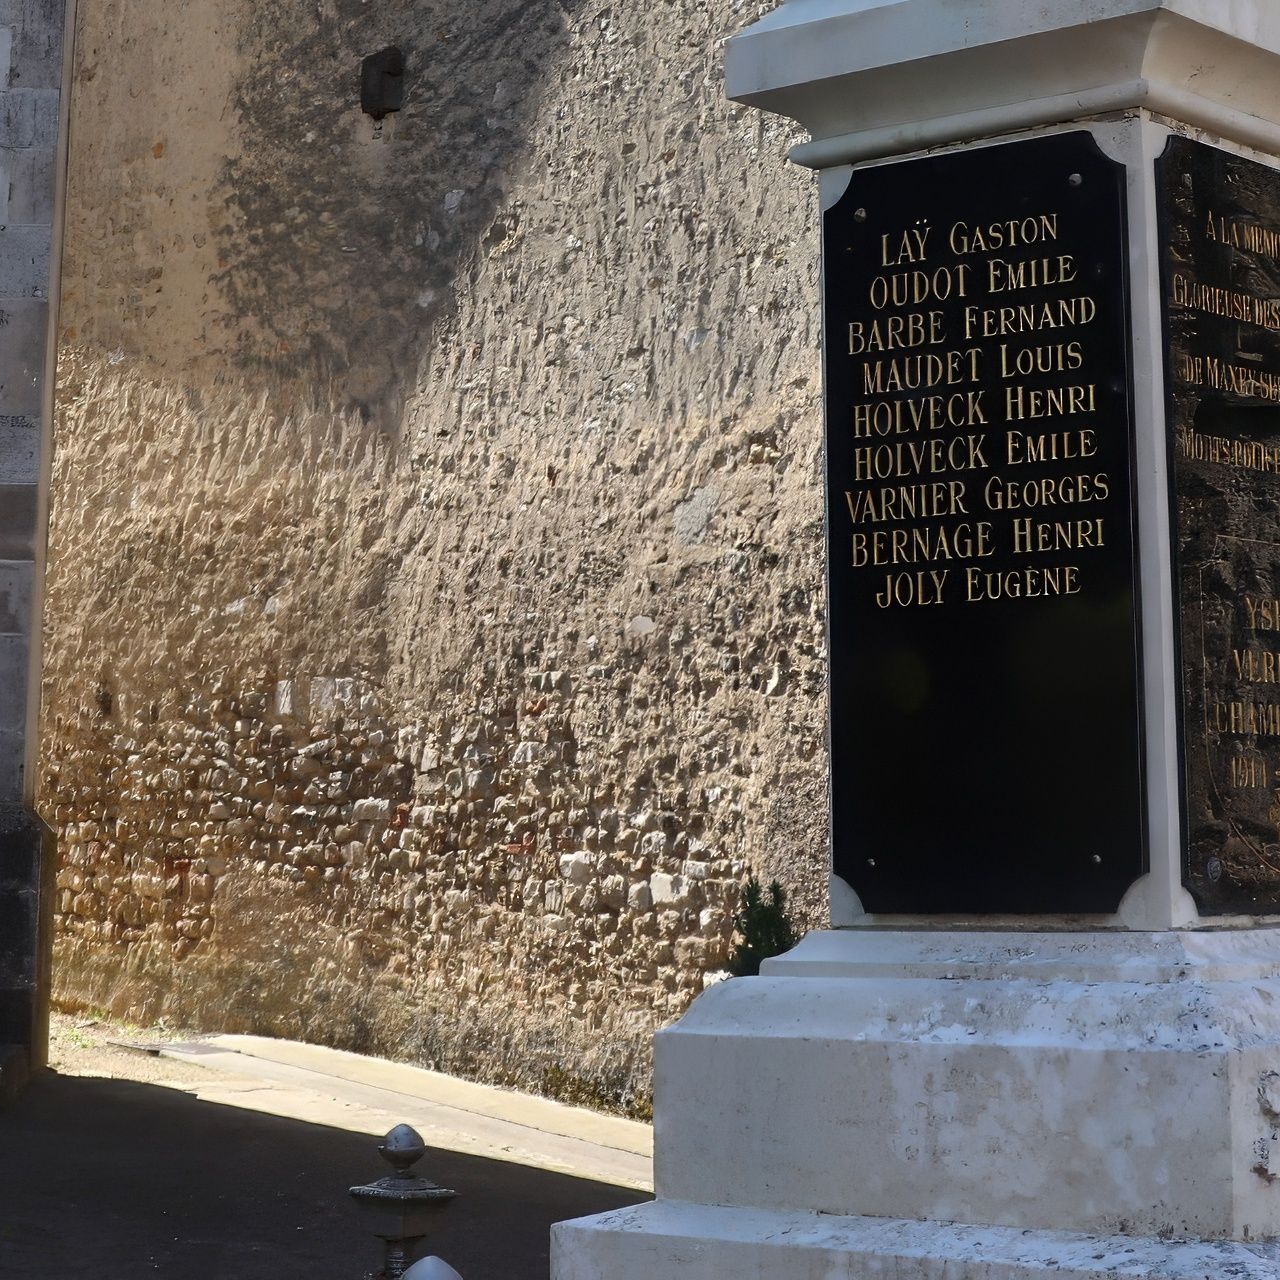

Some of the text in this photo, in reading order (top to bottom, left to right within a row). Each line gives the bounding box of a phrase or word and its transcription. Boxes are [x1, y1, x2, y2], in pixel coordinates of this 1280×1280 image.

[950, 214, 1059, 255] GASTON
[1221, 216, 1239, 248] LA
[869, 255, 1077, 310] OUDOT EMILE
[1173, 273, 1251, 322] GLORIEUSE
[1254, 298, 1280, 329] DES
[847, 296, 1096, 355] BARBE FERNAND
[862, 341, 1083, 395] MAUDET LOUIS
[1184, 354, 1203, 385] DE
[853, 384, 1097, 438] HOLVECK HENRI
[854, 429, 1098, 481] HOLVECK EMILE
[844, 472, 1110, 524] VARNIER GEORGES
[851, 518, 1105, 568] BERNAGE HENRI
[876, 568, 949, 609] JOLY
